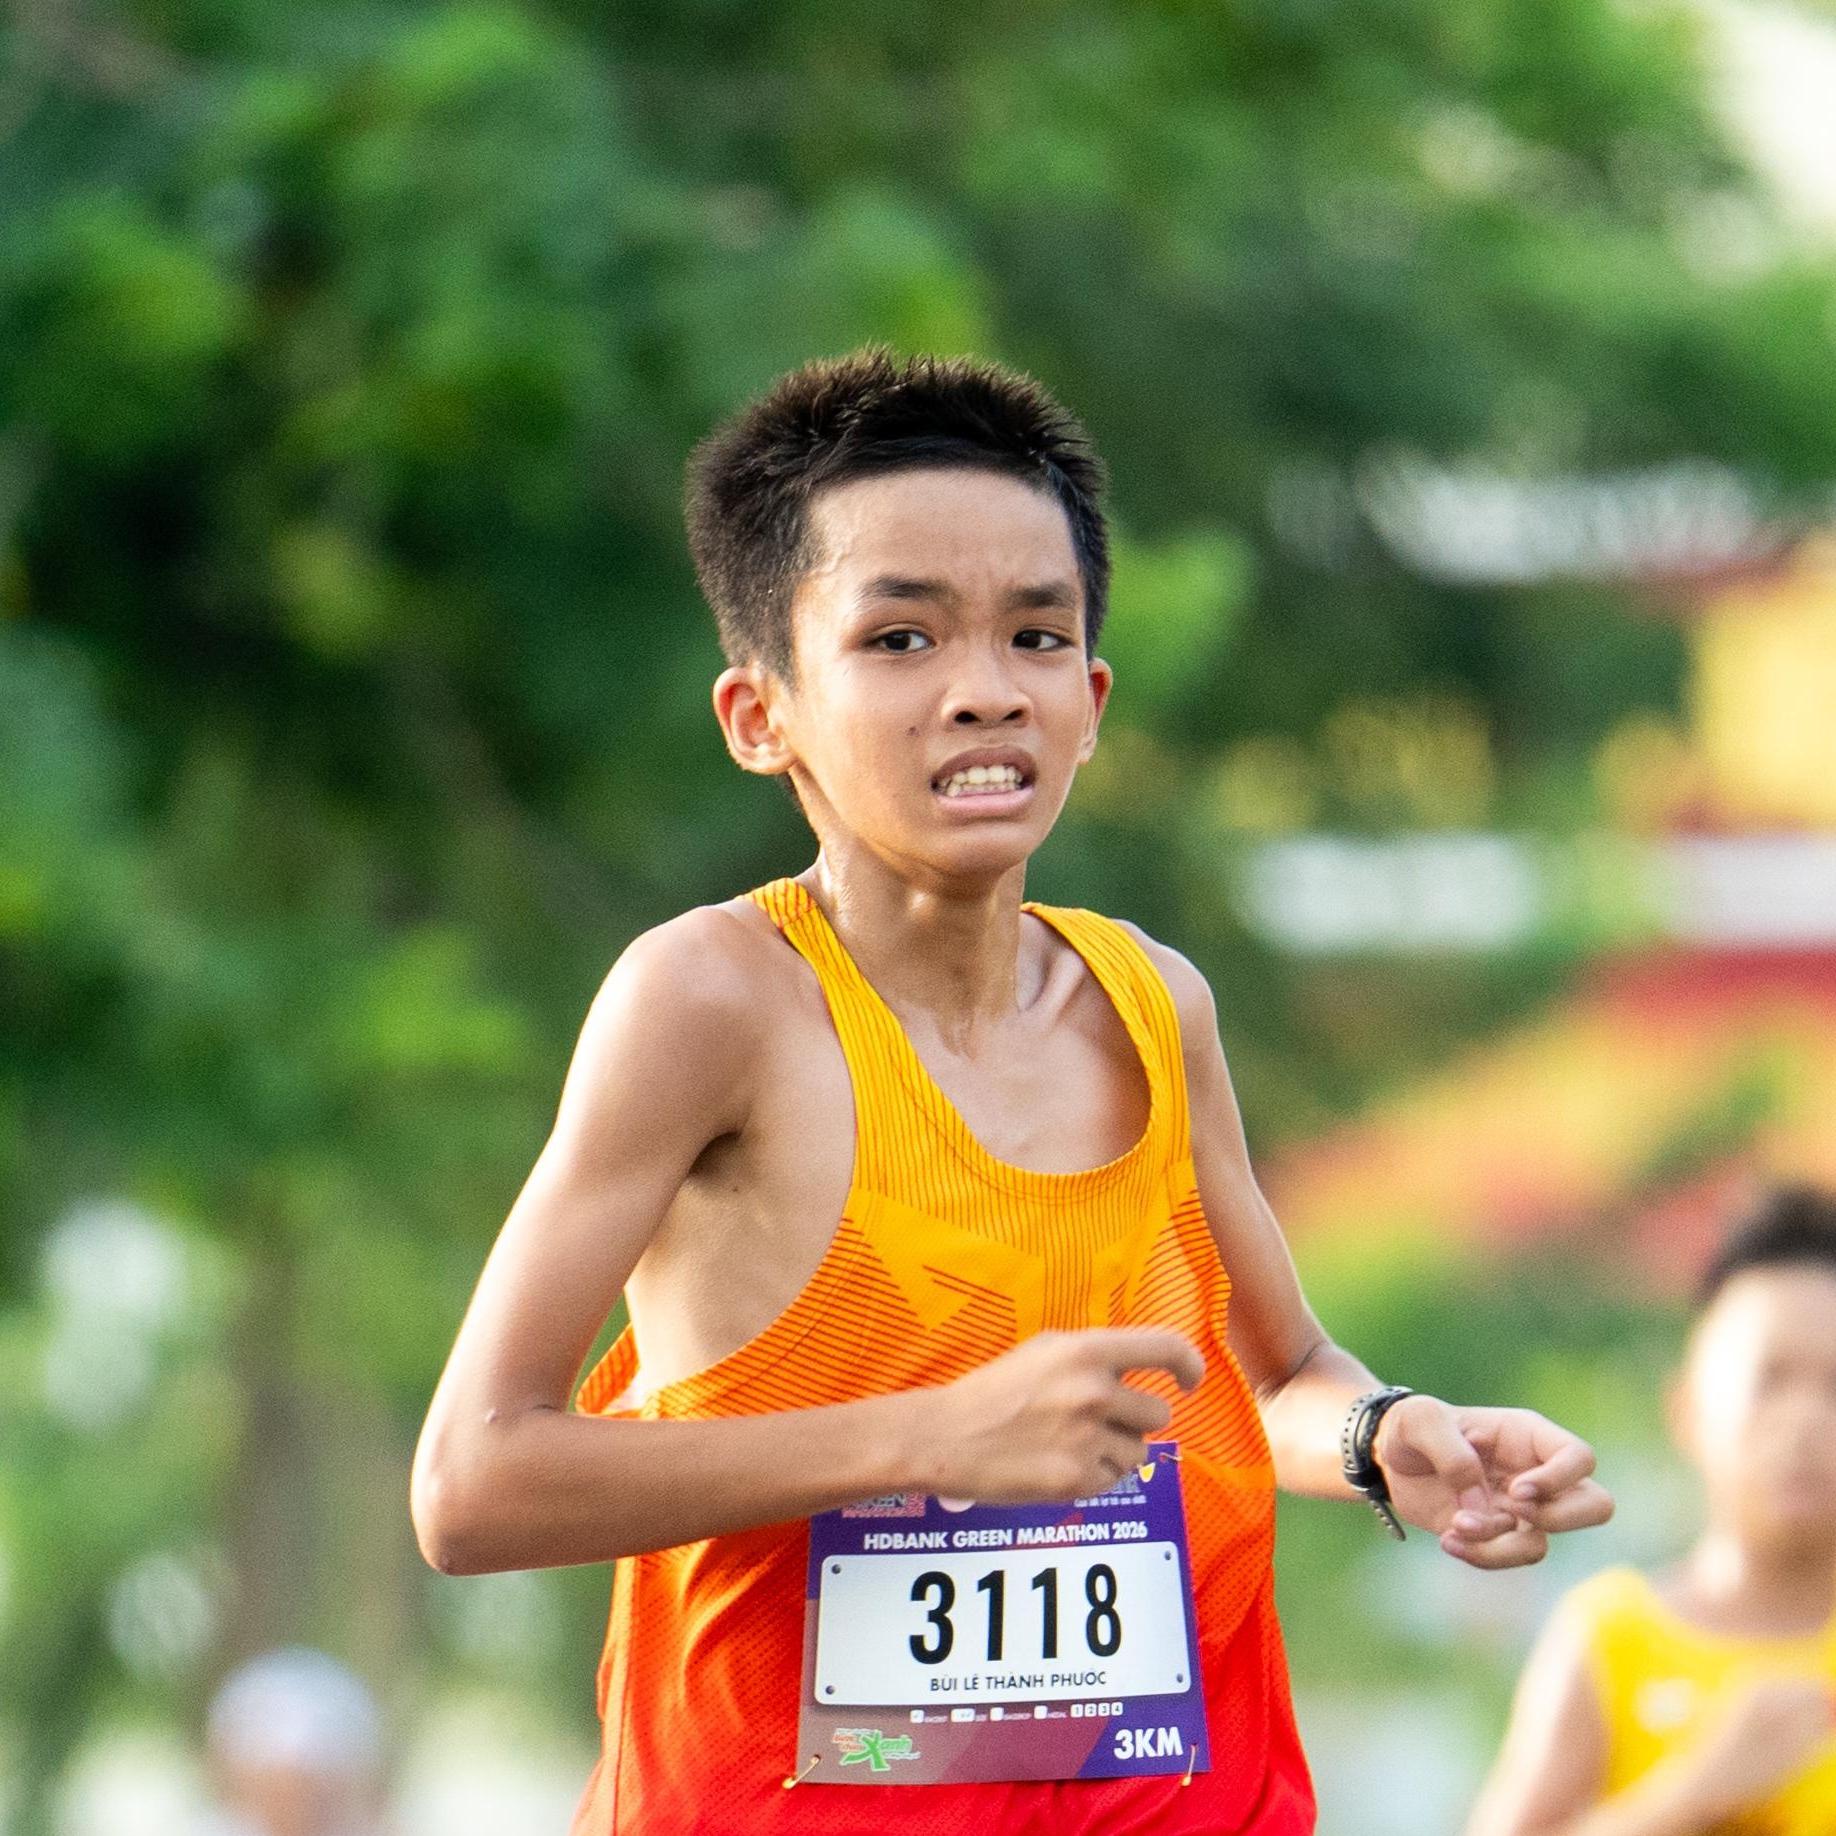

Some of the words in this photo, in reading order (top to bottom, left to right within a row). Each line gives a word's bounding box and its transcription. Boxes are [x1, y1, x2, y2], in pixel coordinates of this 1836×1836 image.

[864, 1531, 948, 1550] HDBANK
[952, 1528, 1013, 1548] GREEN
[1016, 1523, 1110, 1545] MARATHON
[1112, 1521, 1148, 1539] 2026
[909, 1563, 1122, 1665] 3118
[1113, 1726, 1184, 1760] 3KM
